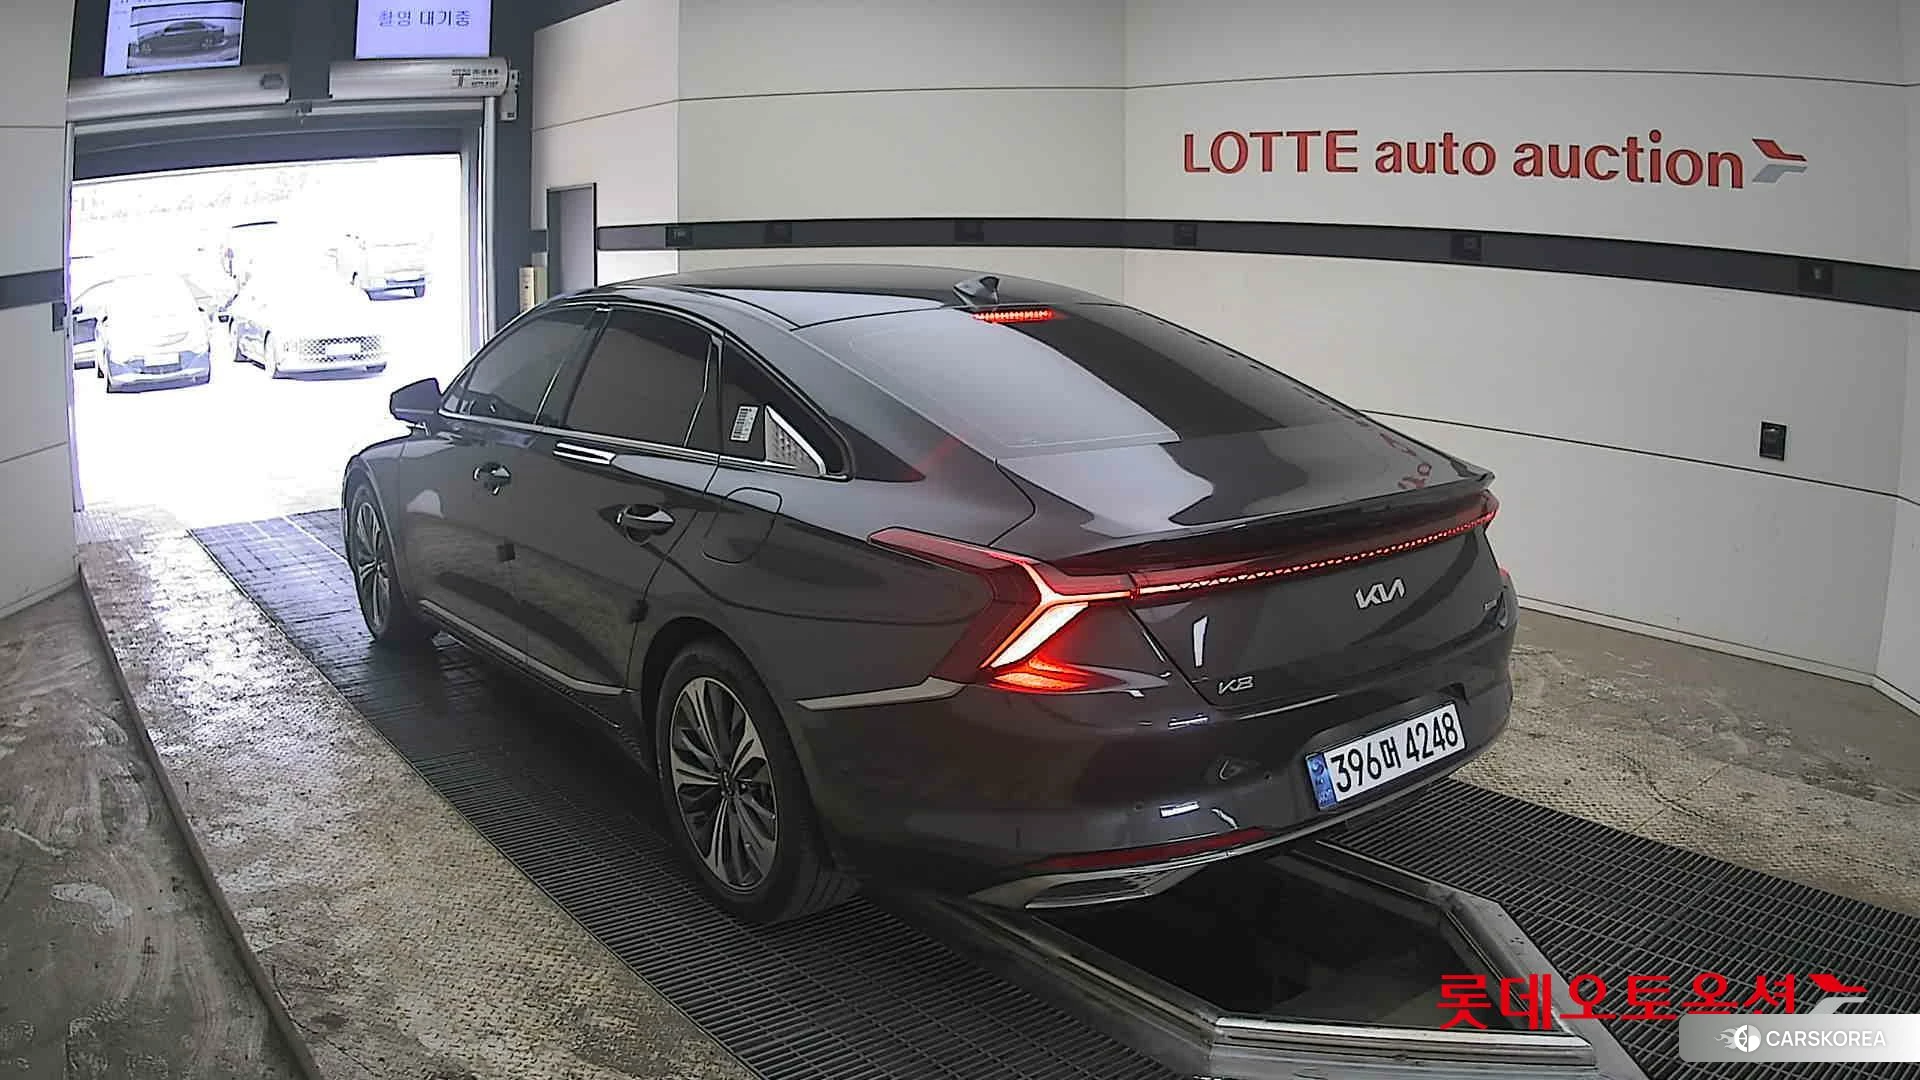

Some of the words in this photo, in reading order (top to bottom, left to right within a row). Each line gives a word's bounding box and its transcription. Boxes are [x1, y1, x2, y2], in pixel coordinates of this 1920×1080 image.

[419, 9, 472, 27] 대기중
[1184, 130, 1358, 173] LOTTE
[1374, 132, 1498, 176] auto
[1513, 130, 1743, 189] auction
[1355, 578, 1405, 609] KIA
[1406, 712, 1459, 762] 4248
